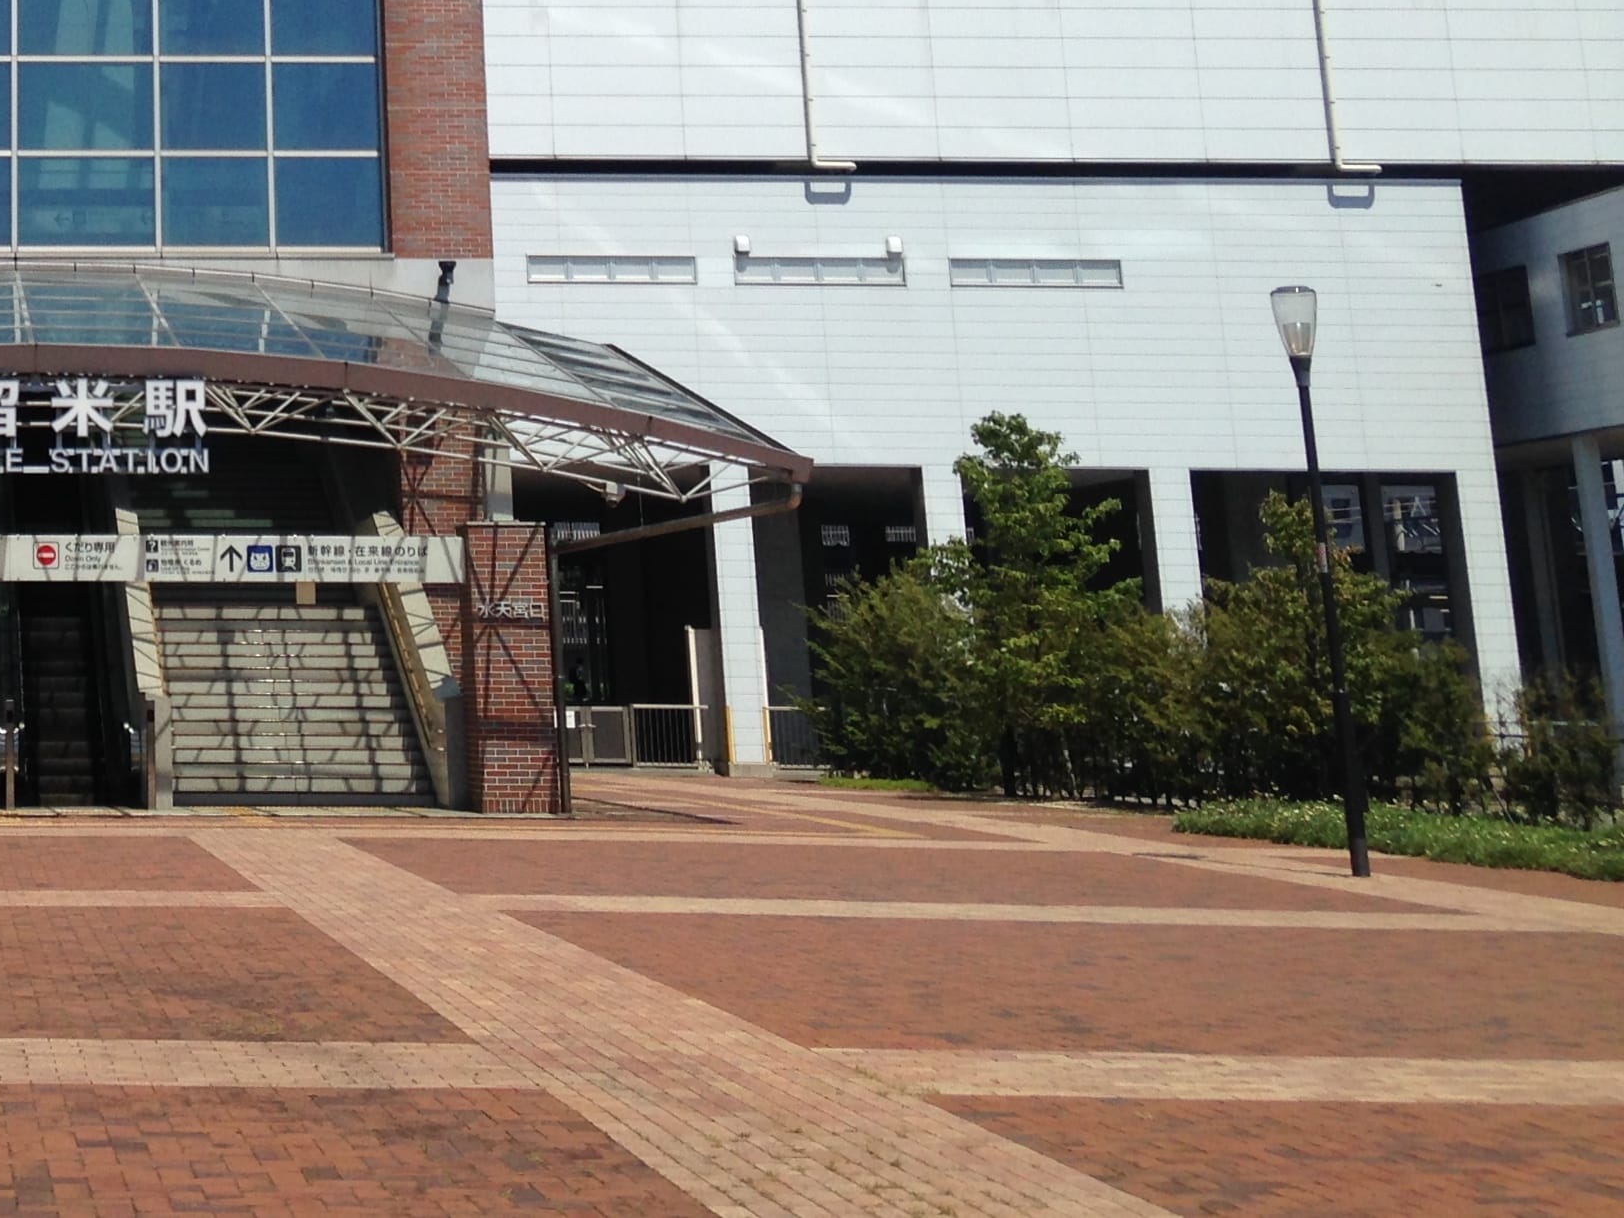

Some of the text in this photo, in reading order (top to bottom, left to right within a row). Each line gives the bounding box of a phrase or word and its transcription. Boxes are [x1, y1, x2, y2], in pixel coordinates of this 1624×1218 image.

[50, 449, 210, 474] STATION
[65, 542, 115, 554] くだり専用
